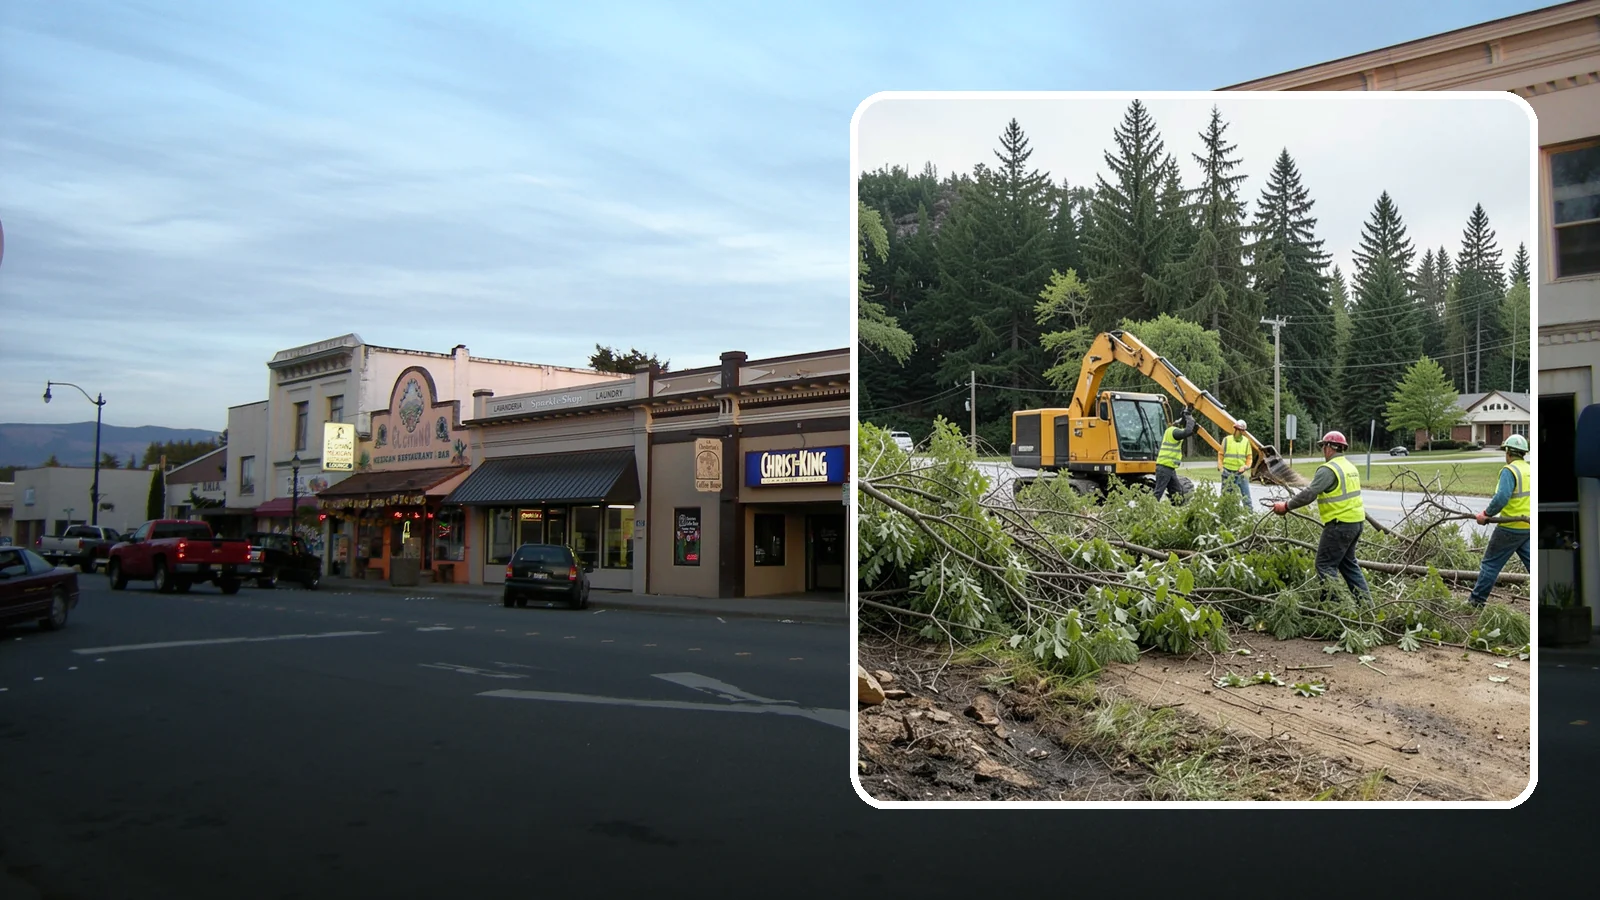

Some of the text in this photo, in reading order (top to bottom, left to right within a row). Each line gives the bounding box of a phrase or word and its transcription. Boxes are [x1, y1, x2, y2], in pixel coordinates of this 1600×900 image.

[530, 394, 582, 409] Sparkle Shop
[595, 389, 624, 400] LAUNDRY
[493, 401, 523, 413] LAVANDERIA
[373, 454, 396, 464] MEXICAN
[397, 451, 433, 463] RESTAURANT
[438, 450, 450, 459] BAR
[760, 449, 827, 478] CHRIST KING
